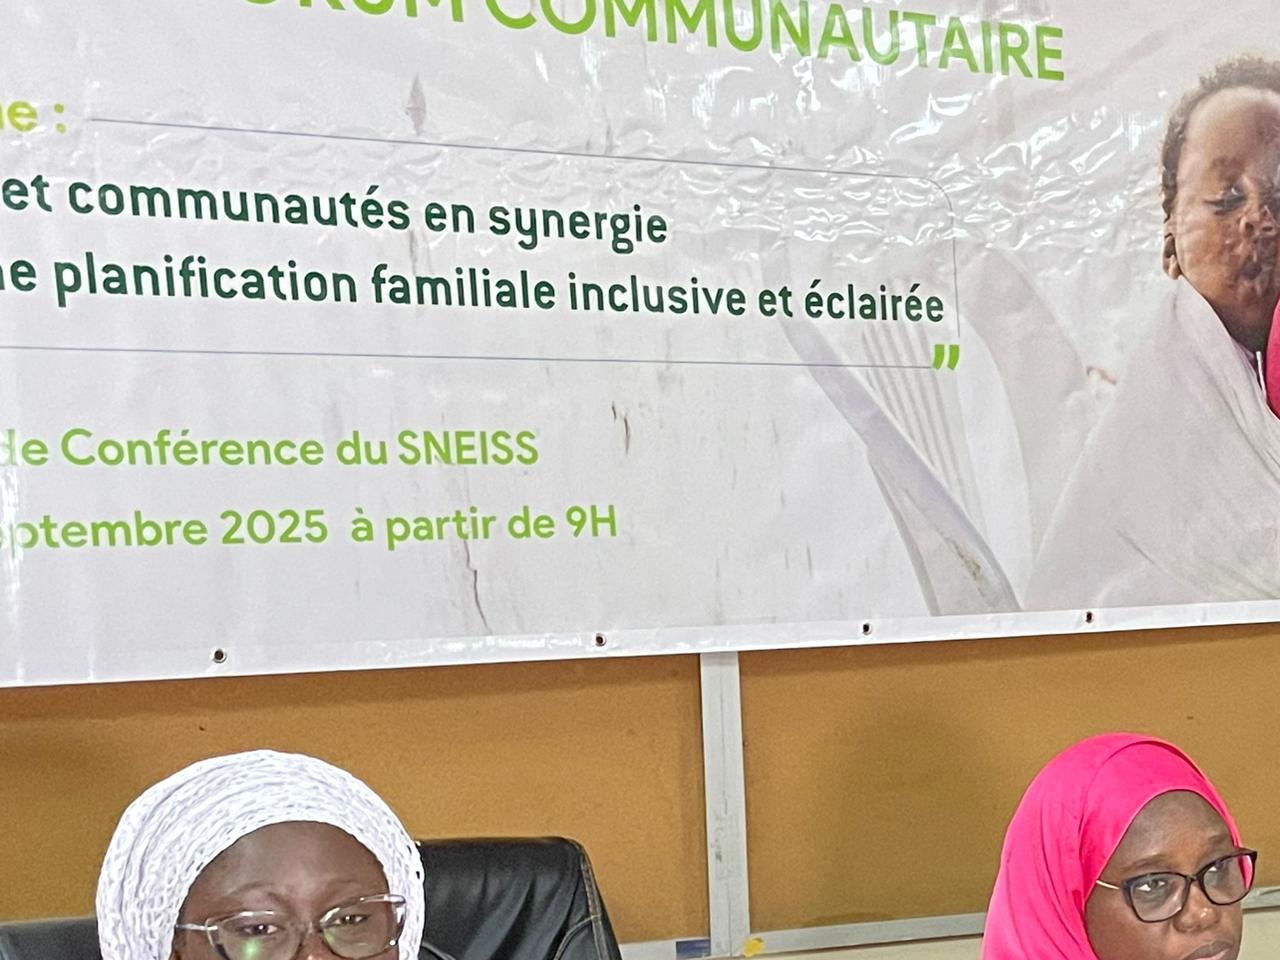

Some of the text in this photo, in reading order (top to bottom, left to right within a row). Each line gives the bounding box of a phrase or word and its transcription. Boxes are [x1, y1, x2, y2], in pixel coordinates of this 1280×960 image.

[0, 101, 38, 132] e
[2, 174, 668, 254] et communautés en synergie
[0, 251, 944, 322] e planification familiale inclusive et éclairée
[60, 428, 324, 466] Conférence
[336, 431, 388, 466] du
[398, 430, 540, 466] SNEISS
[0, 504, 618, 560] ptembre 2025 à partir de 9H
